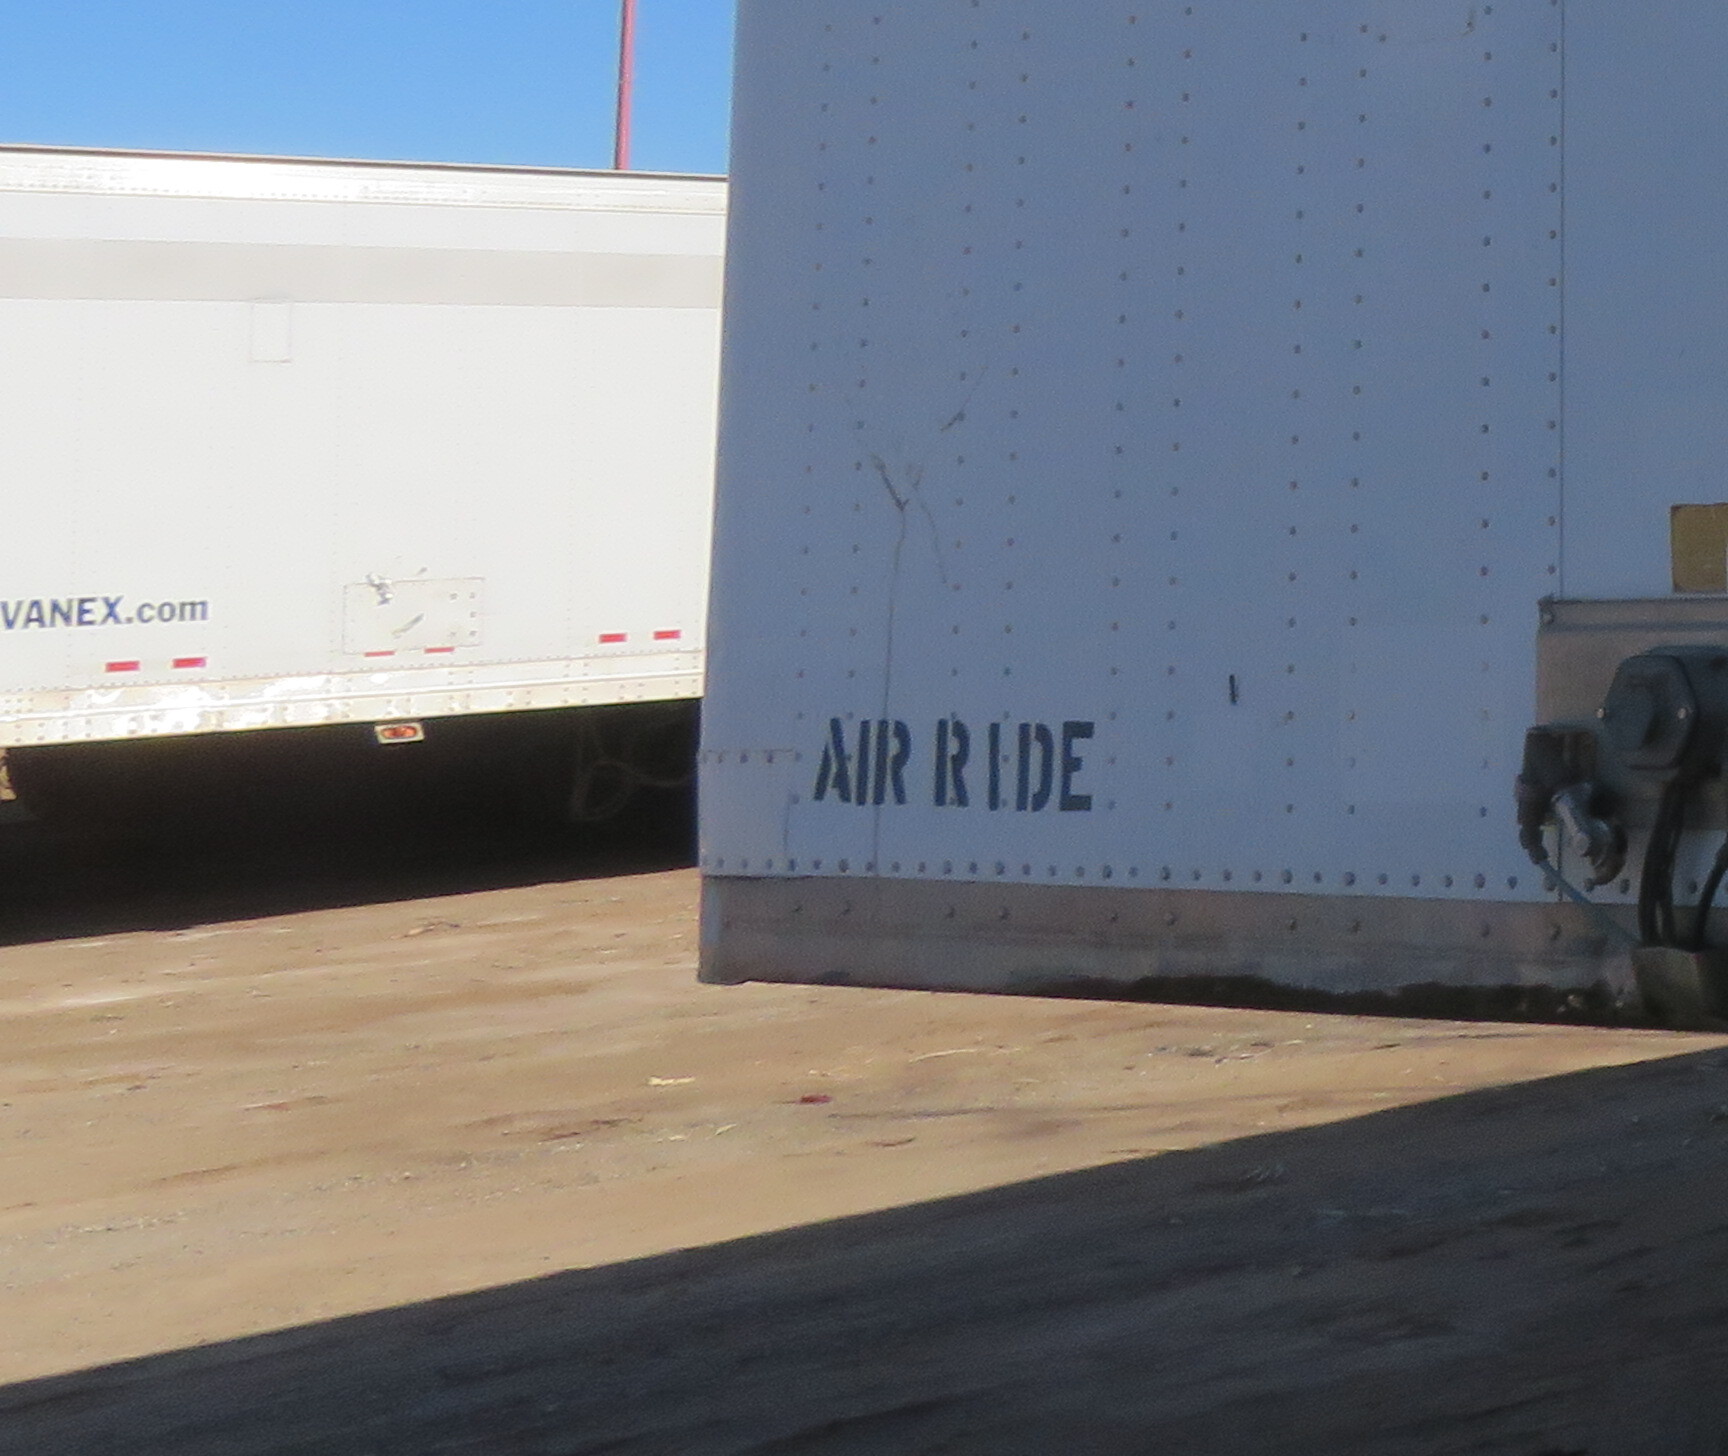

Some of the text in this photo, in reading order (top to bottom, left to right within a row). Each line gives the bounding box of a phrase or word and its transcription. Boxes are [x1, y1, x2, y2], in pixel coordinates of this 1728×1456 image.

[0, 594, 210, 631] VANEX.com
[812, 717, 1096, 812] AIR RIDE
